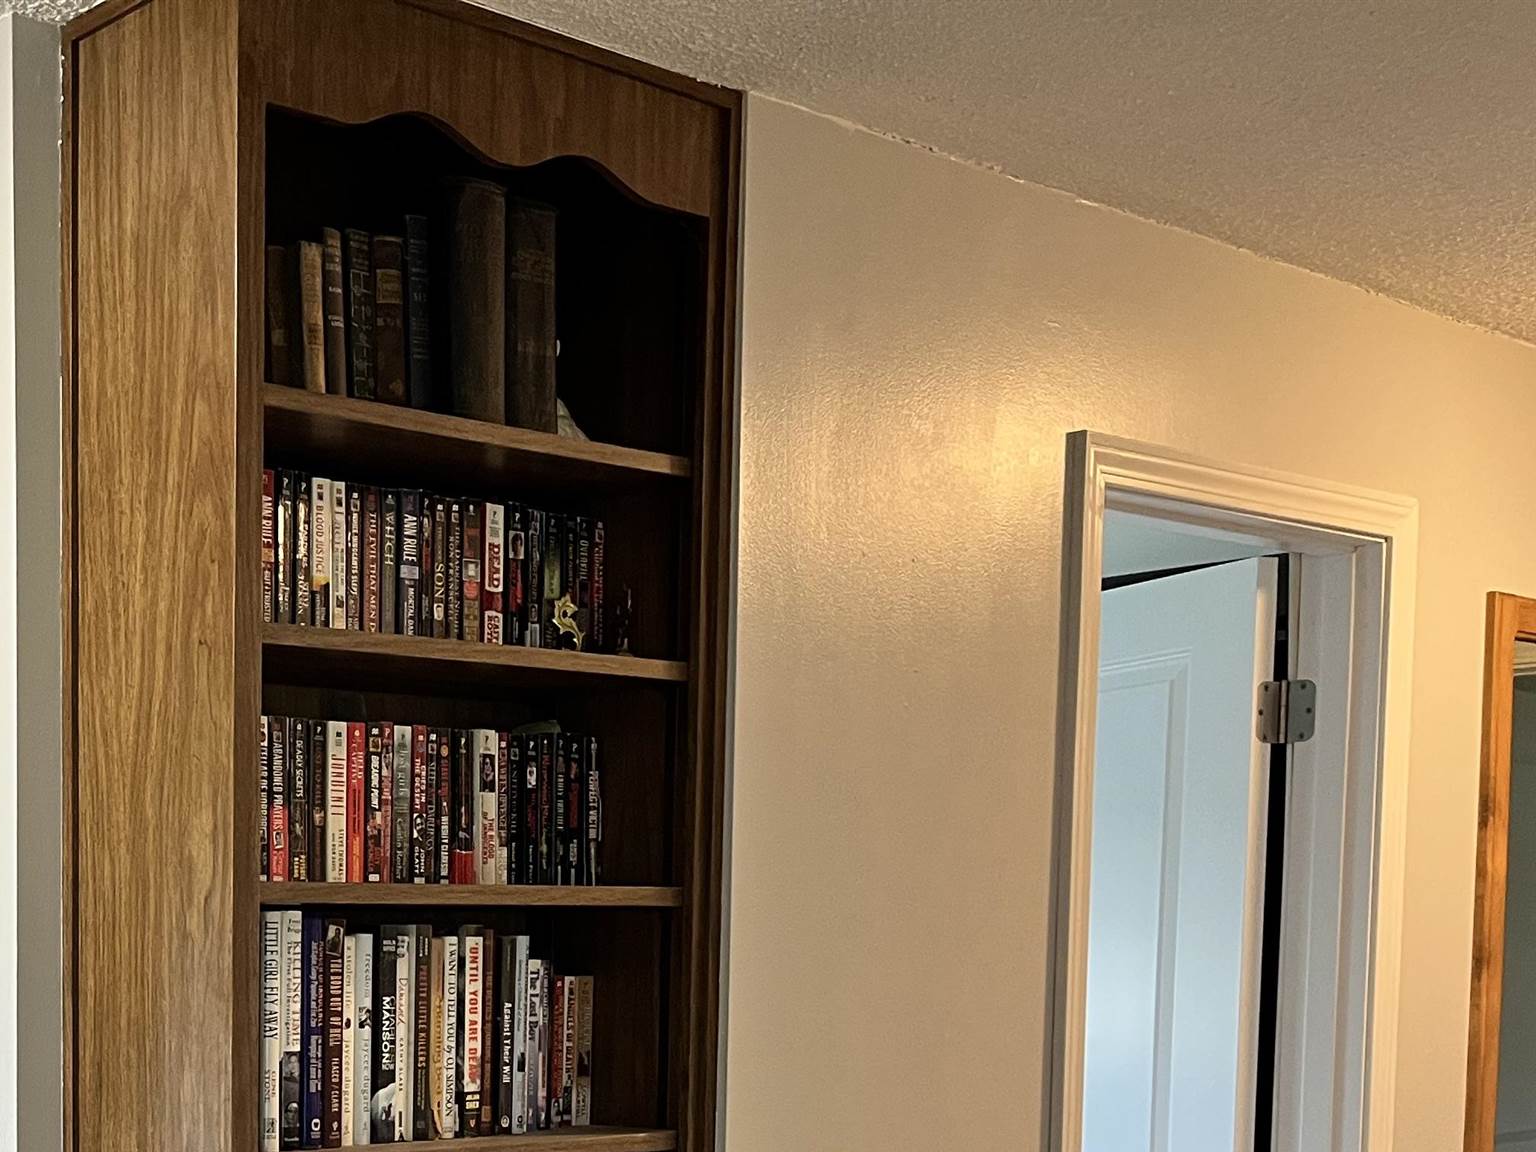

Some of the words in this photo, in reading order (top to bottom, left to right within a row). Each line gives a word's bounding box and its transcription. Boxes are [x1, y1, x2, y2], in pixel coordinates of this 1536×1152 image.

[262, 495, 274, 520] ANN
[316, 505, 324, 537] BLOOD
[404, 514, 417, 536] ANN
[316, 538, 324, 575] JUSTICE
[404, 538, 417, 562] RULE
[492, 544, 500, 588] DEAD
[434, 563, 445, 598] SON
[264, 590, 272, 622] TRUSTED
[272, 742, 283, 792] ABANDONED
[296, 740, 304, 768] DEADLY
[296, 769, 304, 797] SECRETS
[370, 755, 379, 788] BREAKING
[272, 794, 283, 830] PRAYERS
[370, 788, 379, 810] POINT
[420, 793, 426, 803] IN
[426, 804, 436, 850] DARLINGS
[264, 921, 278, 956] LITTLE
[264, 959, 278, 983] GIRL
[292, 942, 300, 1004] KILLING
[330, 959, 342, 972] THE
[364, 954, 372, 998] freedom
[448, 950, 456, 976] WANT
[330, 976, 342, 994] ROAD
[420, 966, 428, 997] PRETTY
[448, 982, 456, 994] TO
[529, 969, 540, 990] The
[264, 987, 278, 1005] FLY
[330, 998, 342, 1012] OUT
[448, 998, 456, 1020] TELL
[469, 990, 478, 1014] YOU
[264, 1010, 278, 1040] AWAY
[292, 1010, 300, 1046] TIME
[330, 1016, 342, 1026] OF
[382, 996, 390, 1062] MANSON
[419, 1001, 427, 1029] LITTLE
[503, 1002, 512, 1036] Against
[330, 1028, 342, 1046] HELL
[469, 1019, 478, 1042] ARE
[528, 1020, 538, 1042] Boy
[362, 1038, 370, 1072] jaycee
[418, 1032, 426, 1068] KILLERS
[503, 1038, 511, 1063] Their
[565, 1046, 573, 1074] DEATH
[502, 1066, 510, 1083] Will
[332, 1090, 340, 1112] CLARK
[343, 1076, 352, 1114] dugard
[361, 1075, 370, 1113] dugard
[446, 1074, 454, 1116] SIMPSON
